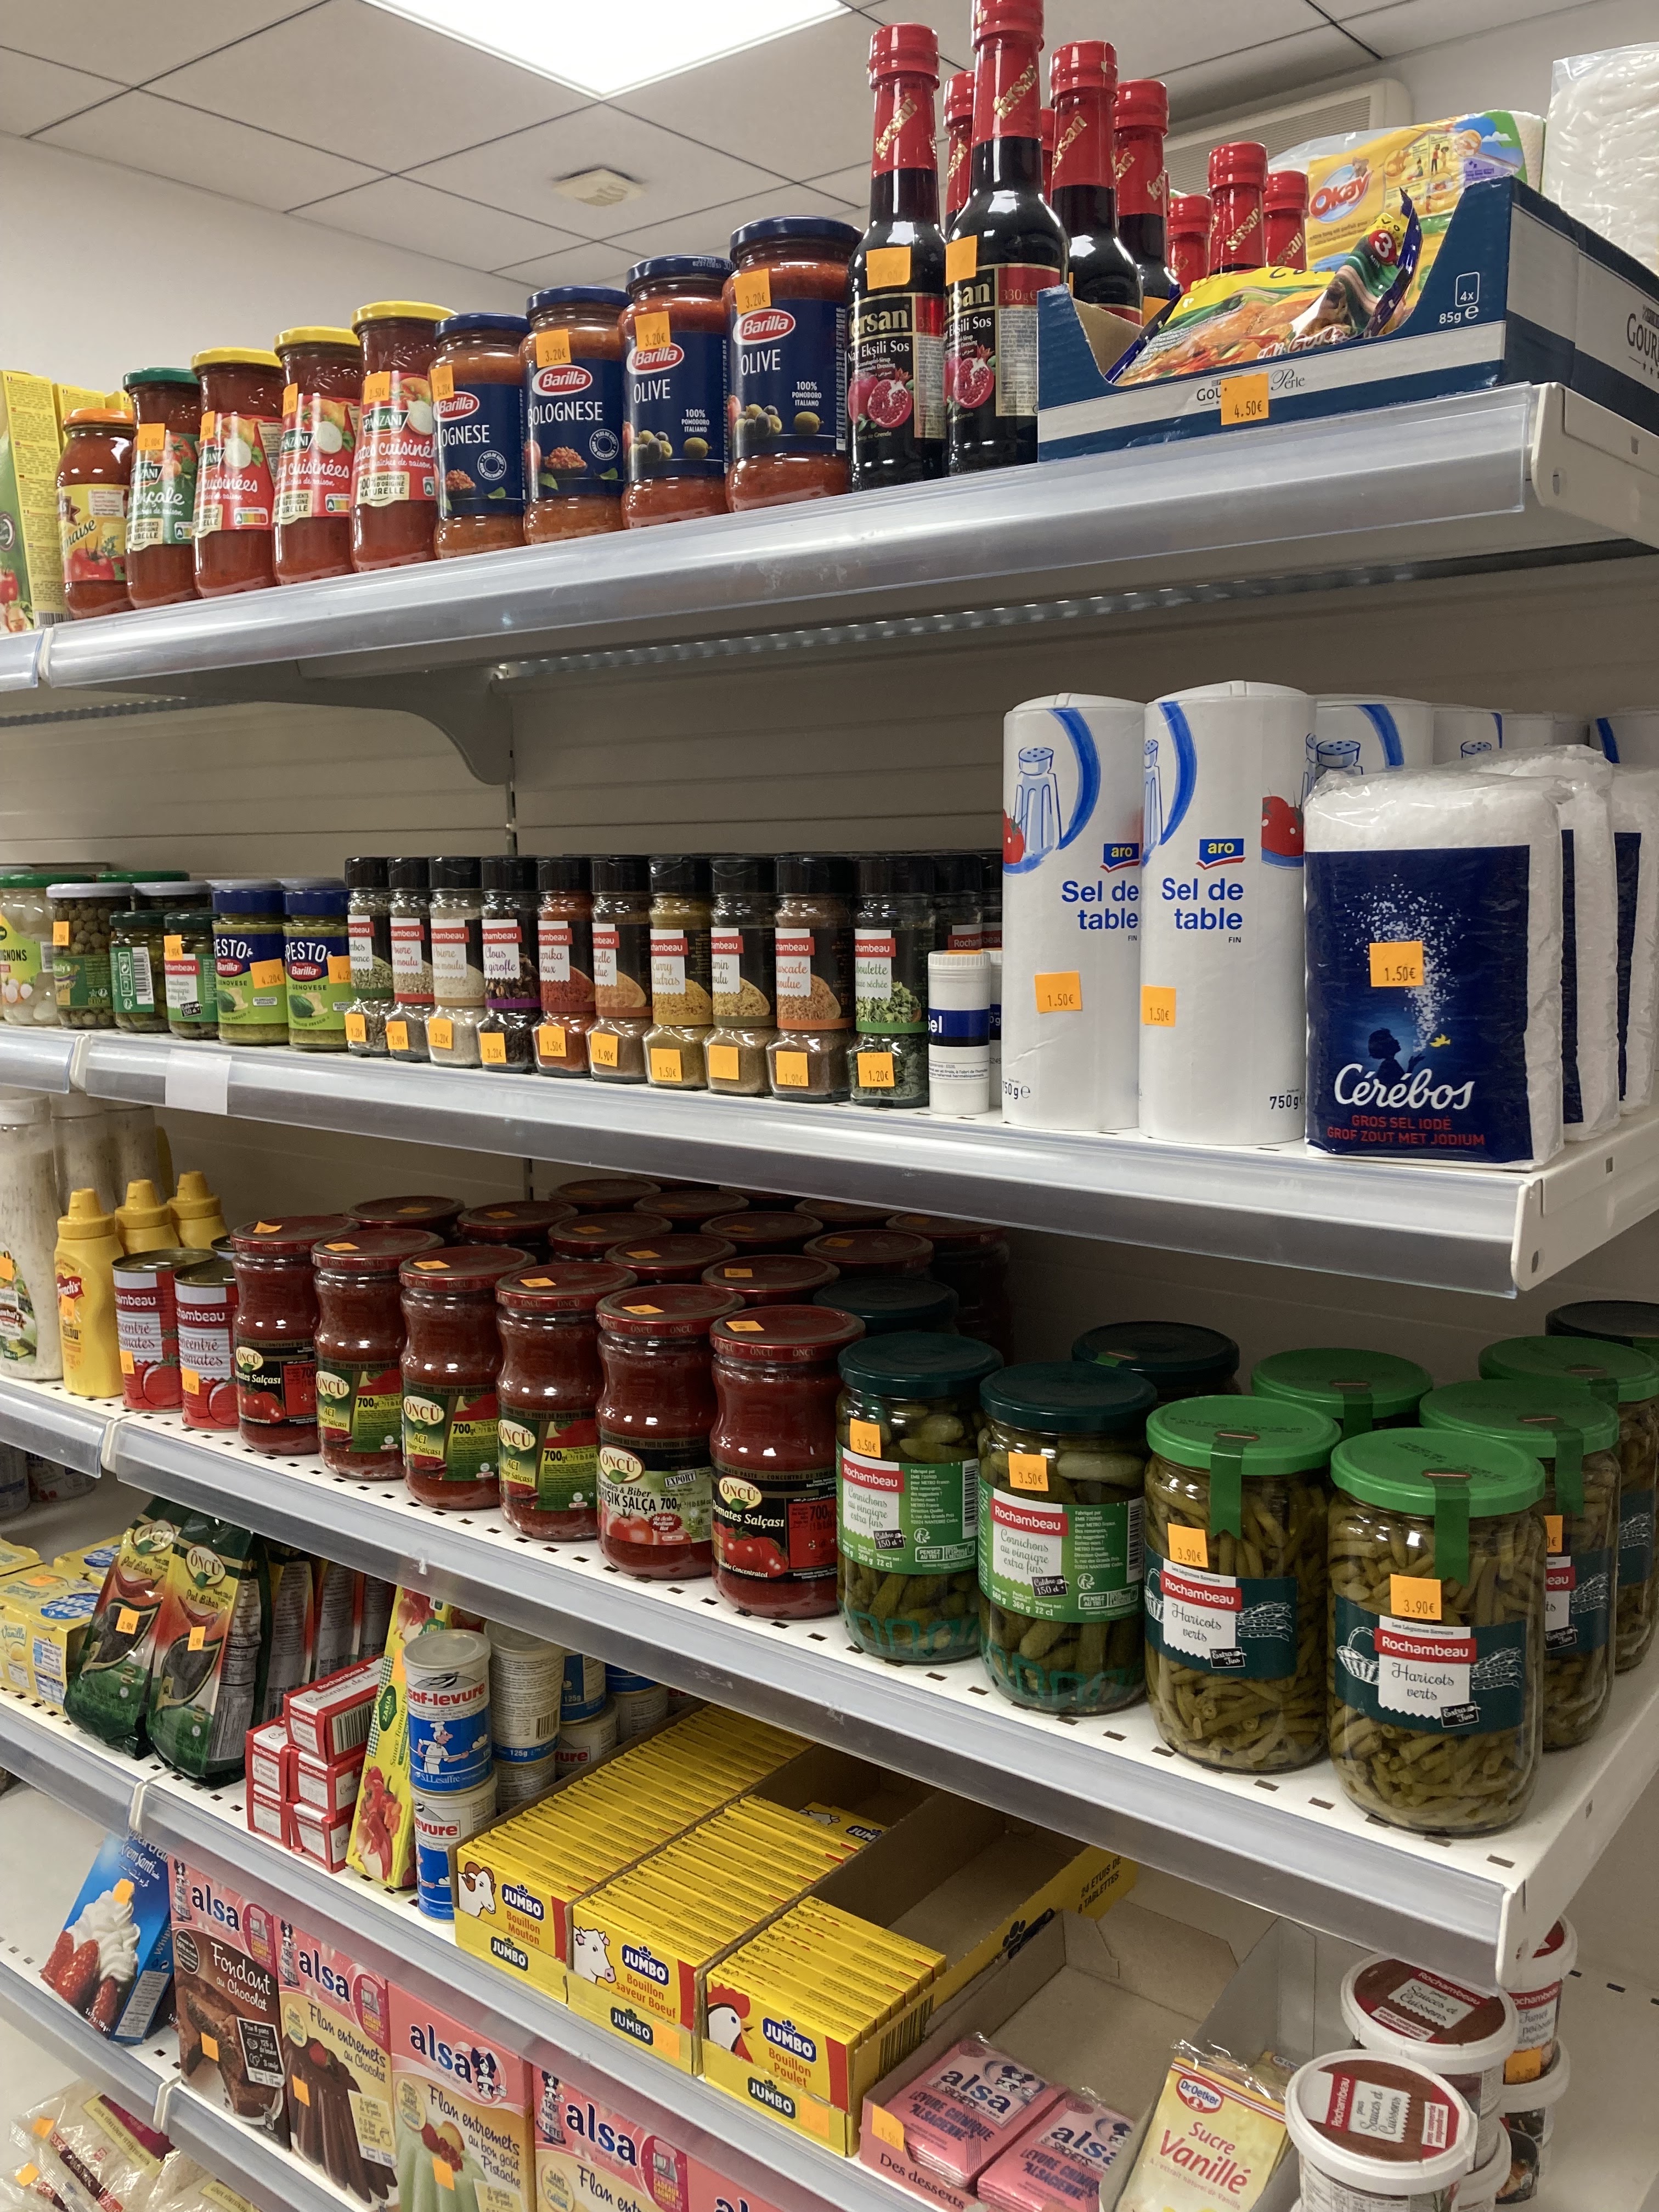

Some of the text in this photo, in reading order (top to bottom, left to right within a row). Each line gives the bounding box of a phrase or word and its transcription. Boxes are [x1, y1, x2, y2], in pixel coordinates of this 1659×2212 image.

[1374, 233, 1392, 258] 3
[1370, 255, 1380, 268] MIN
[746, 292, 765, 308] 3.20€
[1460, 291, 1474, 301] 4x
[742, 315, 788, 336] Barilla
[973, 316, 992, 329] Sos
[1439, 312, 1462, 324] 85g
[645, 332, 665, 346] 3.20€
[890, 340, 910, 352] Sos
[545, 348, 566, 362] 3.20€
[636, 348, 678, 365] Barilla
[741, 349, 781, 376] OLIVE
[543, 371, 586, 387] Barilla
[796, 381, 817, 391] 100%
[1271, 368, 1305, 391] Perle
[634, 379, 670, 404] OLIVE
[439, 399, 473, 413] Barilla
[527, 401, 603, 427] BOLOGNESE
[685, 409, 706, 417] 100%
[1234, 400, 1262, 418] 4.50€
[364, 415, 403, 429] PANZANI
[1111, 846, 1132, 857] aro
[1207, 842, 1234, 855] aro
[1061, 881, 1139, 902] Sel de
[1162, 878, 1244, 901] Sel de
[1078, 910, 1138, 930] table
[1175, 908, 1243, 930] table
[286, 941, 326, 962] PESTO
[485, 949, 506, 960] Clous
[217, 963, 238, 972] Barilla
[291, 967, 317, 976] Barilla
[1385, 967, 1415, 982] 1.50€
[262, 974, 281, 985] 4.20€
[1047, 994, 1074, 1007] 1.50€
[1150, 1008, 1169, 1022] 1.50€
[546, 1041, 562, 1051] 1.50€
[598, 1048, 613, 1060] 1.90€
[659, 1066, 676, 1078] 1.50€
[868, 1070, 888, 1082] 1.20€
[1334, 1064, 1475, 1110] Cérébos
[1352, 1115, 1452, 1129] GROS SEL IODÉ
[1327, 1128, 1485, 1146] GROF ZOUT MET JODIUM
[251, 1374, 280, 1385] Salçası
[405, 1398, 440, 1421] ÖNCÜ
[500, 1423, 531, 1447] ÖNCÜ
[857, 1439, 876, 1452] 3.50€
[602, 1450, 635, 1473] ÖNCÜ
[666, 1472, 696, 1487] EXPORT
[844, 1464, 898, 1487] Rochambeau
[1019, 1471, 1042, 1485] 3.50€
[627, 1486, 652, 1498] Biber
[723, 1480, 757, 1501] ÖNCÜ
[848, 1485, 888, 1508] Cornichons
[623, 1495, 656, 1514] SALÇA
[713, 1500, 784, 1527] Domates Salçası
[856, 1505, 888, 1520] vinaigre
[868, 1517, 883, 1528] fins
[995, 1505, 1061, 1531] Rochambeau
[1001, 1528, 1048, 1553] Cornichons
[1001, 1544, 1049, 1564] au vinaigre
[1178, 1547, 1202, 1562] 3.90€
[1003, 1558, 1043, 1575] extra fins
[1037, 1585, 1052, 1595] 150
[1165, 1578, 1234, 1605] Rochambeau
[1012, 1600, 1024, 1610] 360
[1404, 1599, 1435, 1614] 3.90€
[1172, 1603, 1222, 1630] Haricots
[1183, 1629, 1207, 1641] verts
[1382, 1637, 1469, 1657] Rochambeau
[1391, 1662, 1454, 1686] Haricots
[408, 1682, 485, 1706] saf-levure
[1407, 1686, 1437, 1700] verts
[1443, 1707, 1466, 1718] Extra
[192, 1883, 240, 1931] alsa
[504, 1889, 542, 1917] JUMBO
[506, 1910, 540, 1935] Bouillon
[508, 1922, 540, 1945] Mouton
[492, 1941, 527, 1967] JUMBO
[211, 1942, 270, 1995] Fondant
[624, 1950, 667, 1981] JUMBO
[298, 1949, 351, 2003] alsa
[227, 1978, 268, 2012] Chocolat
[627, 1973, 665, 2001] Bouillon
[616, 1982, 676, 2019] saveur Boeuf
[308, 2002, 386, 2068] Flan entremets
[613, 2012, 651, 2041] JUMBO
[766, 2023, 814, 2058] JUMBO
[410, 2023, 472, 2084] alsa
[769, 2047, 811, 2078] Bouillon
[774, 2062, 808, 2088] Poulet
[751, 2082, 793, 2113] JUMBO
[940, 2070, 1011, 2115] alsa
[427, 2084, 520, 2157] Flan entremets
[566, 2103, 637, 2167] alsa
[1188, 2121, 1236, 2155] Sucre
[481, 2154, 521, 2189] Pistache
[1160, 2129, 1252, 2195] Vanillé
[880, 2153, 964, 2210] Des desserts
